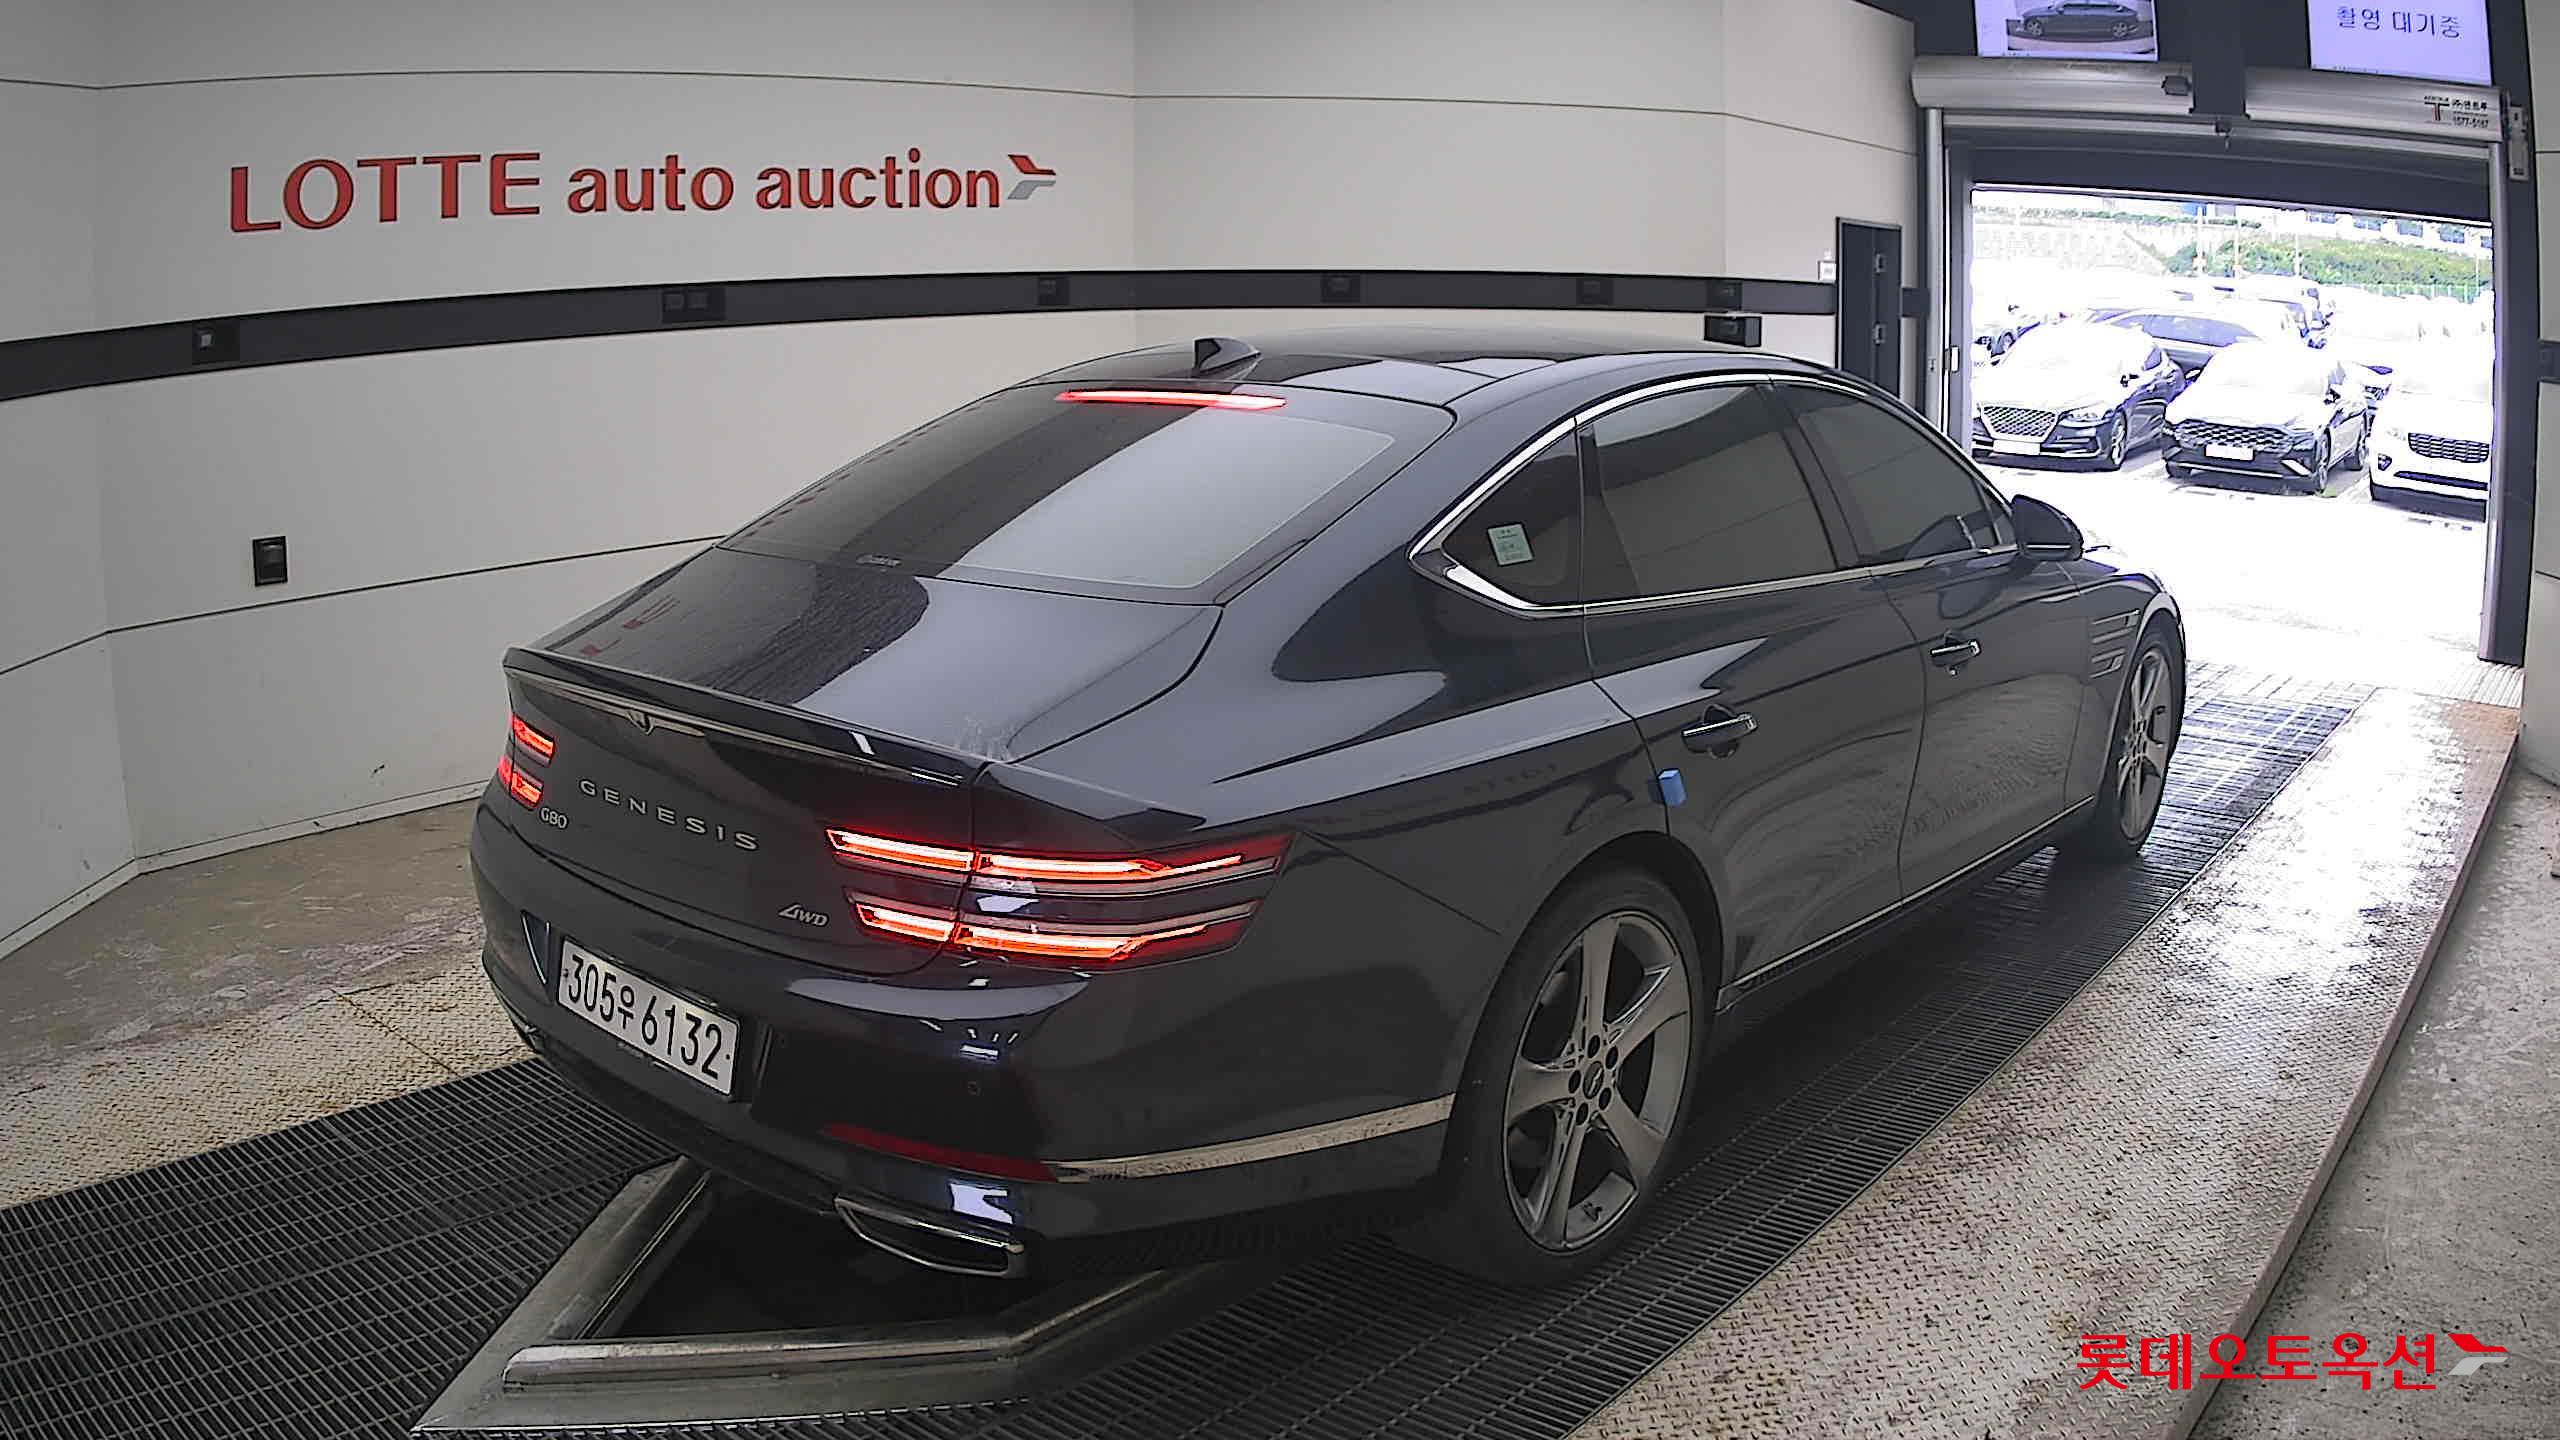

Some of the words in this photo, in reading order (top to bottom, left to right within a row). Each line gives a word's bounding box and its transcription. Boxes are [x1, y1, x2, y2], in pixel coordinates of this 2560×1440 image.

[2337, 6, 2380, 31] 촬영
[2392, 11, 2461, 39] 대기중
[230, 151, 541, 233] LOTTE
[566, 154, 735, 213] auto
[755, 147, 1001, 209] auction
[540, 807, 568, 829] G80
[579, 780, 758, 850] GENESIS
